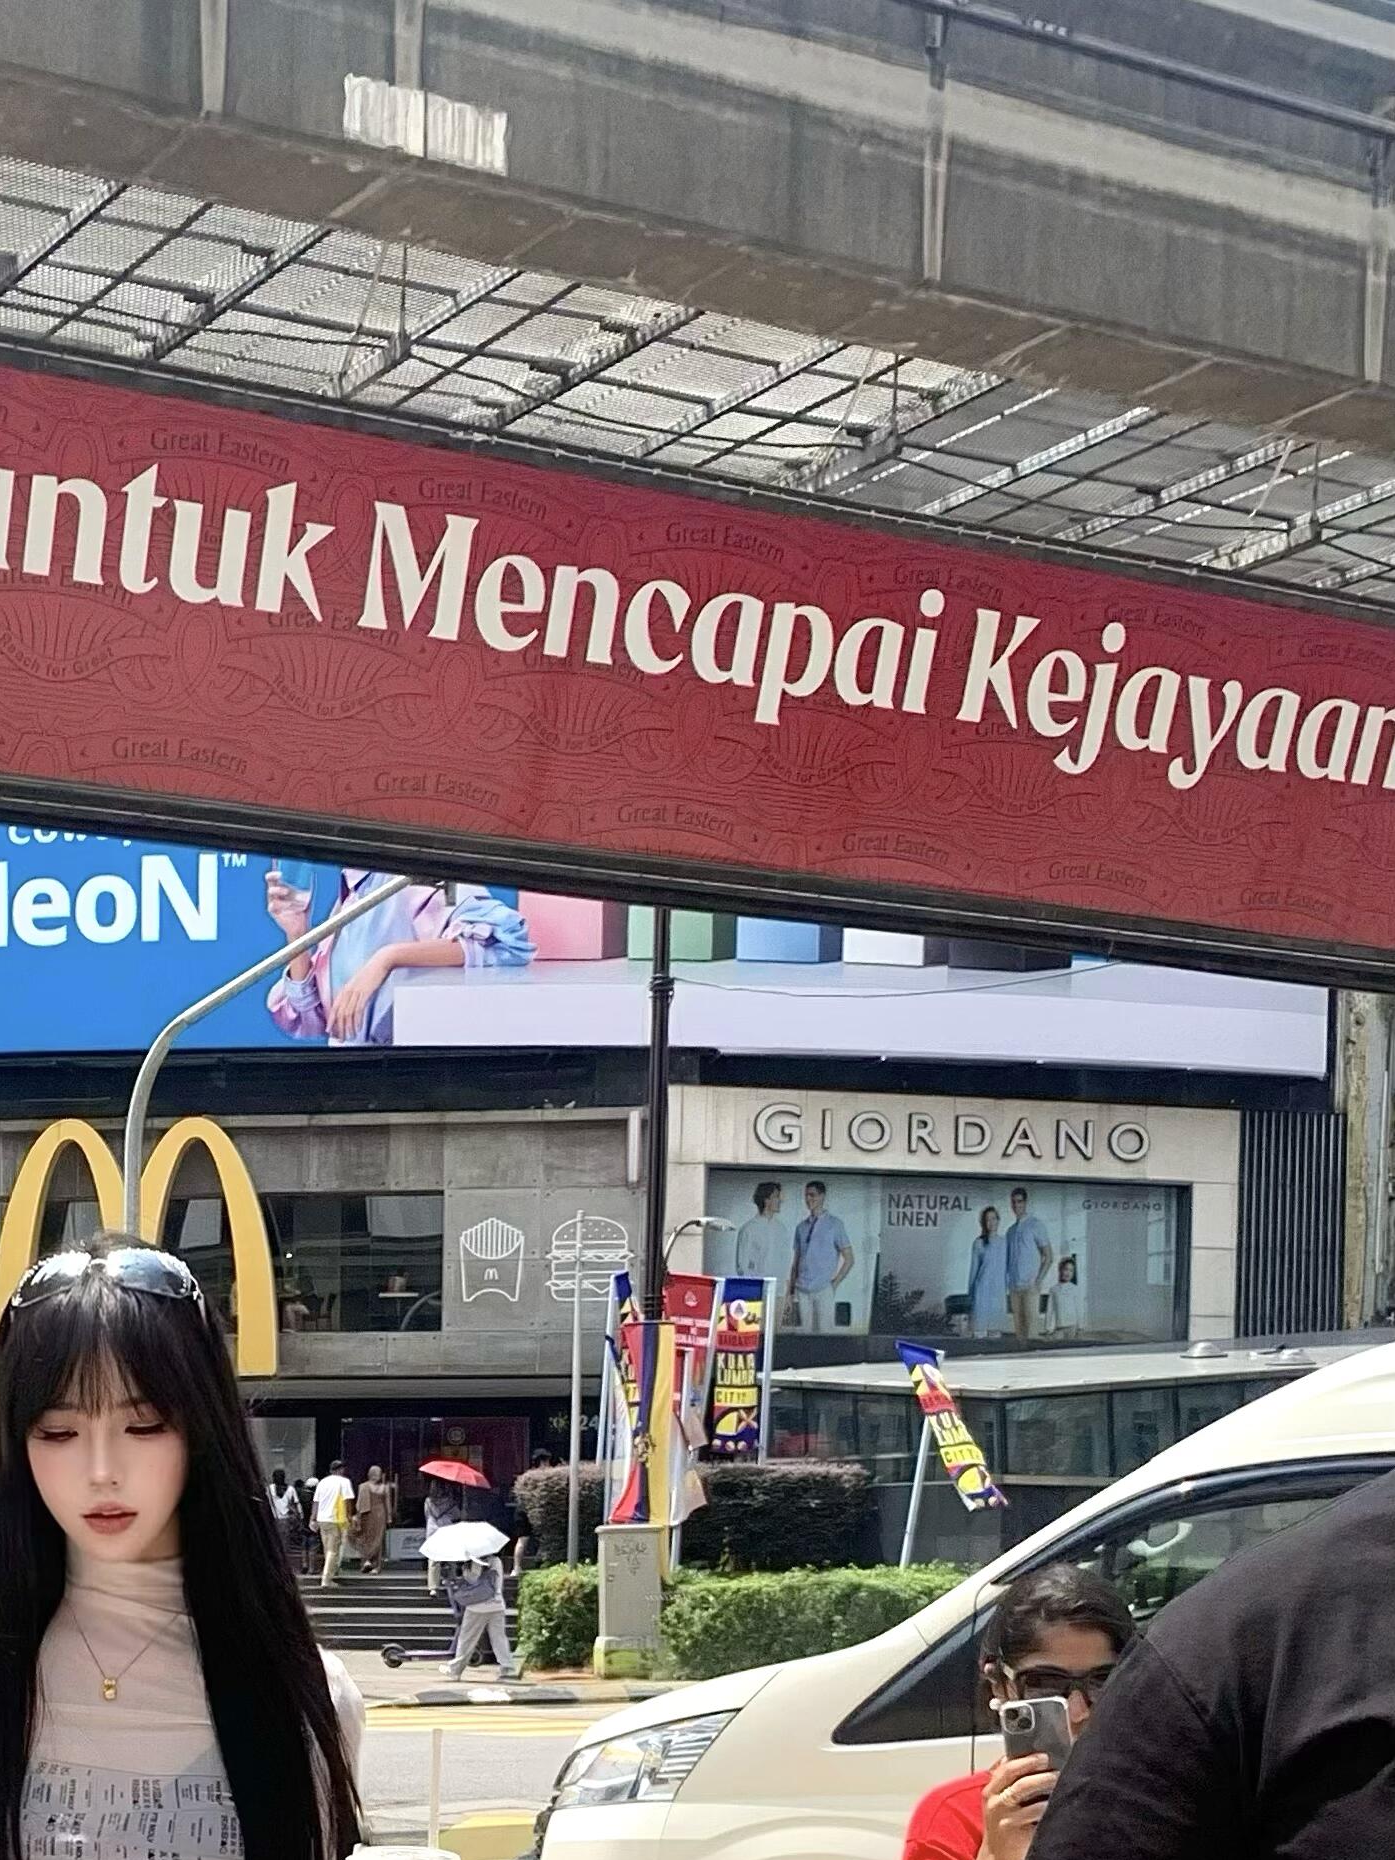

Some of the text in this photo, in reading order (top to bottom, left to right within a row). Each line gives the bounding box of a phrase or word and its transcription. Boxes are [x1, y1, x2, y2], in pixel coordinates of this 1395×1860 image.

[149, 427, 290, 472] Great Eastern
[418, 478, 548, 521] Great Eastern
[666, 522, 785, 564] Great Eastern
[357, 500, 946, 727] Mencapai
[955, 607, 1395, 791] Kejayaan
[112, 734, 248, 776] Great Eastern
[373, 769, 500, 807] Great Eastern
[617, 802, 735, 836] Great Eastern
[841, 833, 891, 854] Great
[754, 1102, 1151, 1162] GIORDANO
[887, 1193, 972, 1212] NATURAL
[887, 1209, 938, 1227] LINEN
[1082, 1198, 1162, 1212] GIORDANO
